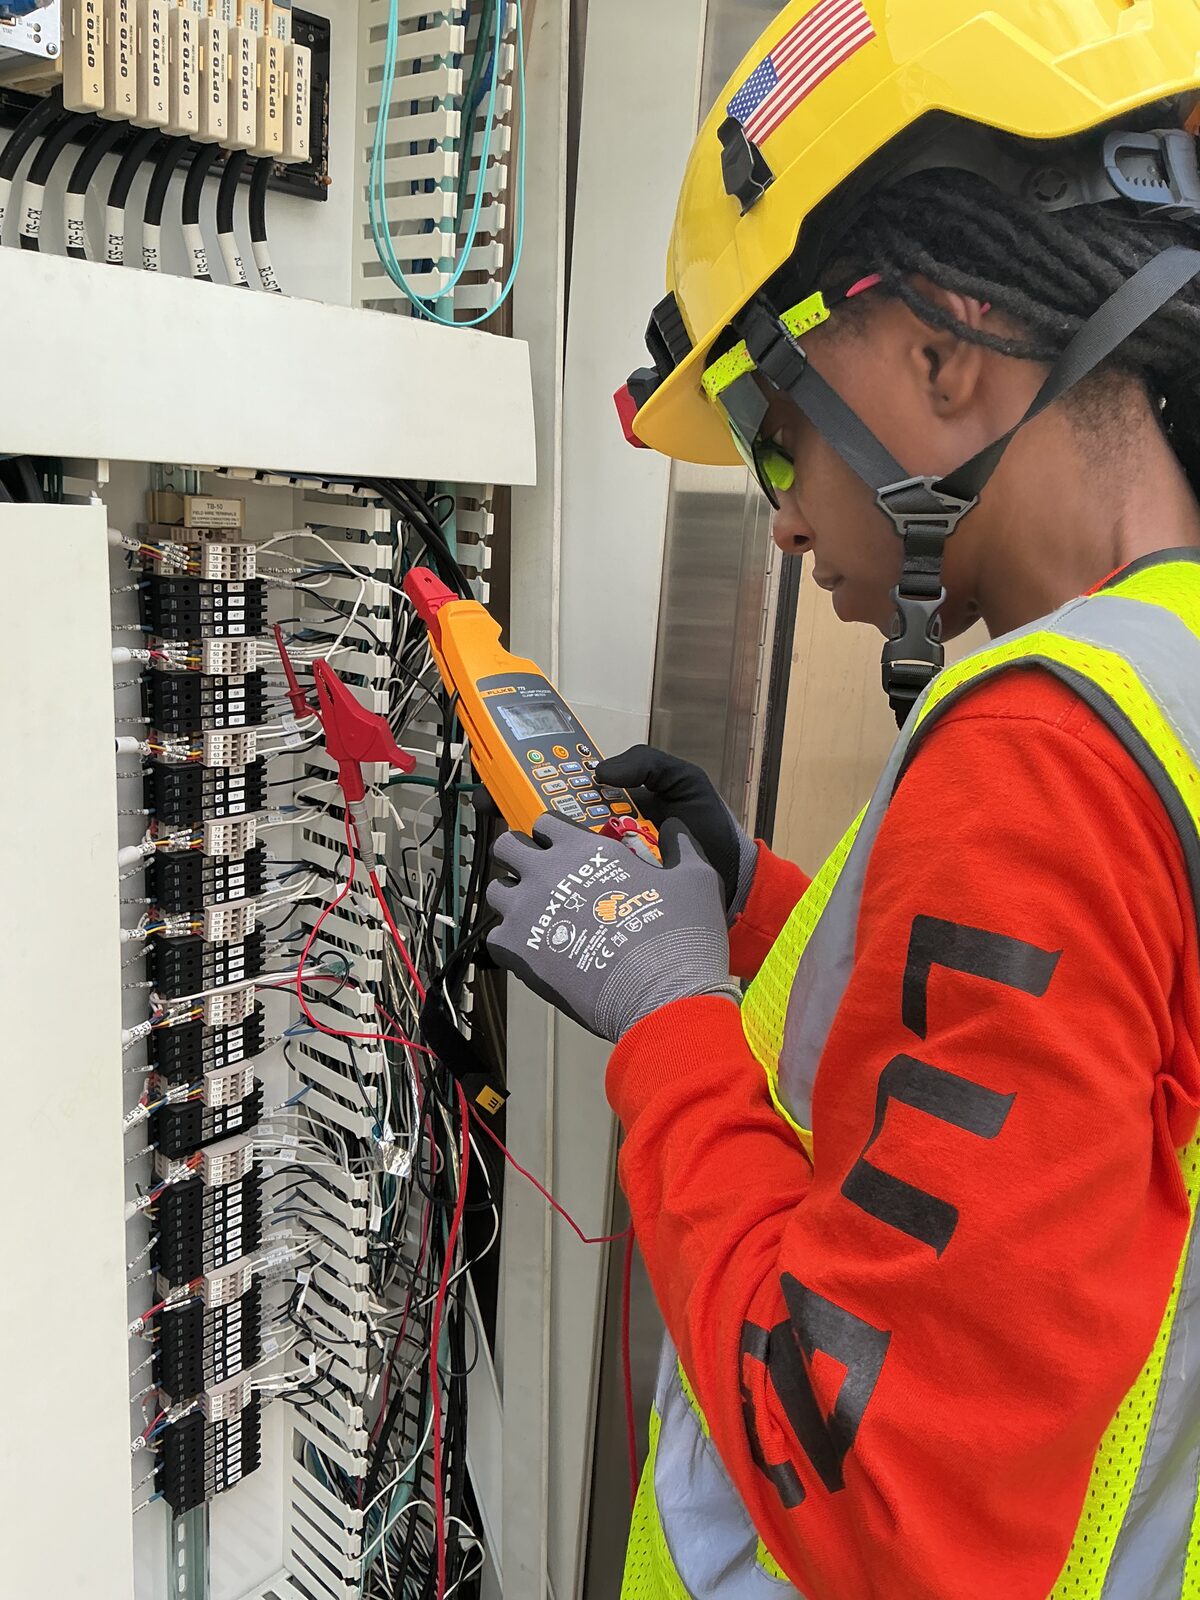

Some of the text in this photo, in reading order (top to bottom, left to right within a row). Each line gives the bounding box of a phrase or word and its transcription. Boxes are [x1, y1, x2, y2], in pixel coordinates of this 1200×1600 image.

[153, 9, 160, 34] 22
[183, 19, 190, 43] 22
[87, 18, 95, 68] OPTO
[213, 29, 220, 52] 22
[242, 38, 249, 61] 22
[120, 28, 128, 78] OPTO
[269, 47, 276, 69] 22
[297, 56, 303, 78] 22
[26, 208, 42, 234] R3-S1
[68, 219, 84, 246] R3-S2
[108, 234, 124, 260] R3-S3
[259, 266, 278, 290] R3-S7
[562, 804, 578, 812] SOURCE
[599, 866, 624, 884] 34-874
[613, 871, 631, 883] 7(S)
